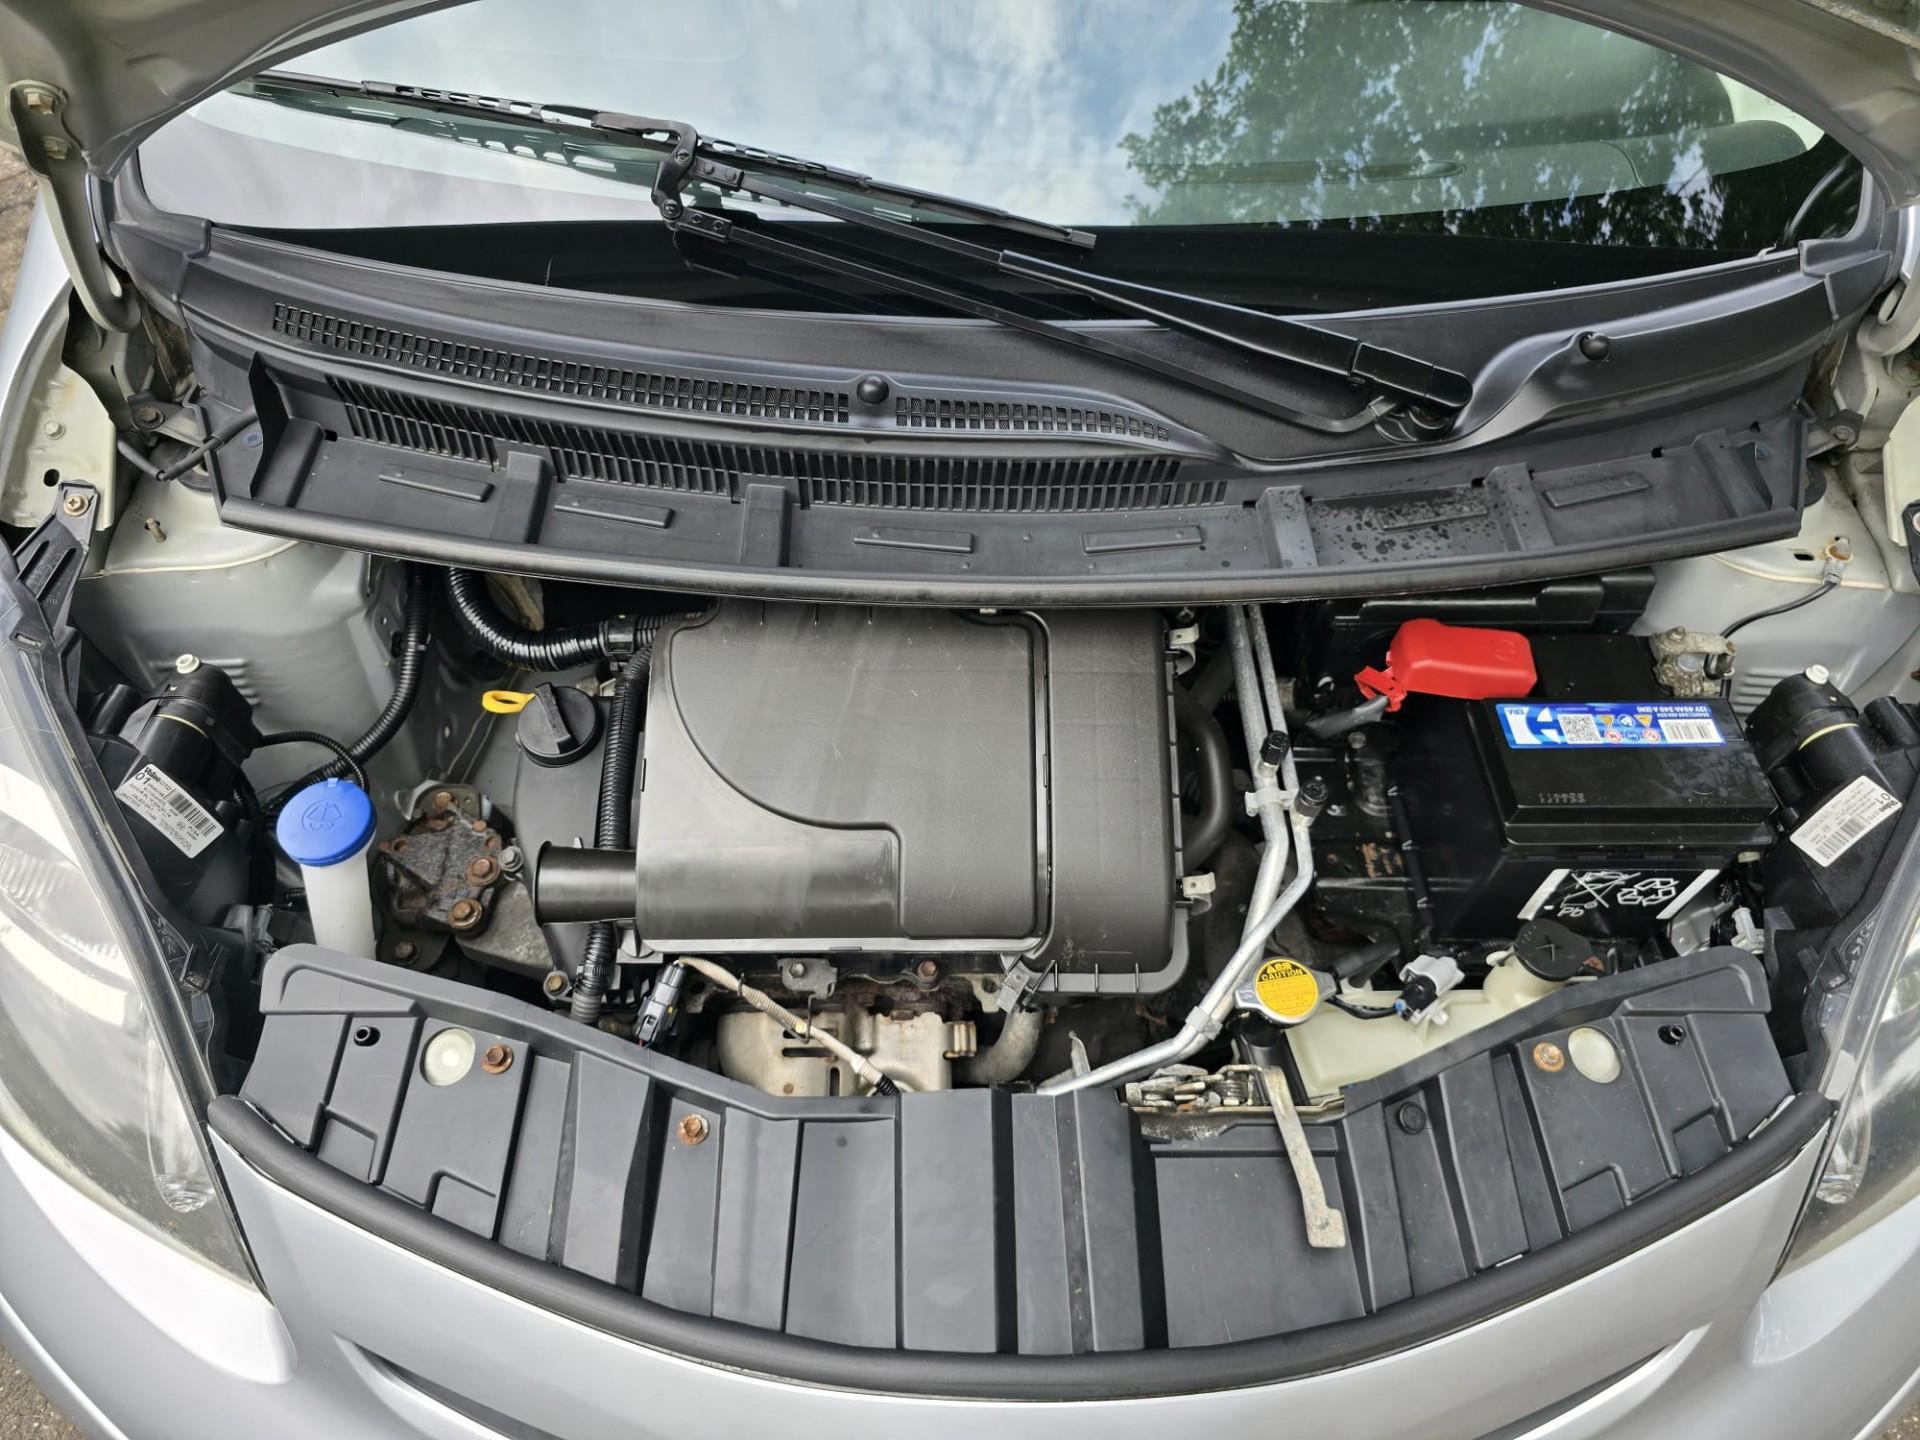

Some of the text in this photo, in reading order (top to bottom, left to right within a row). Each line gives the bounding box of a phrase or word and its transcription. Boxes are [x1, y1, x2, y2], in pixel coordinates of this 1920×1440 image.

[134, 770, 151, 786] 01
[1874, 791, 1890, 806] 01
[1557, 907, 1585, 917] Pb
[1262, 969, 1303, 980] CAUTION
